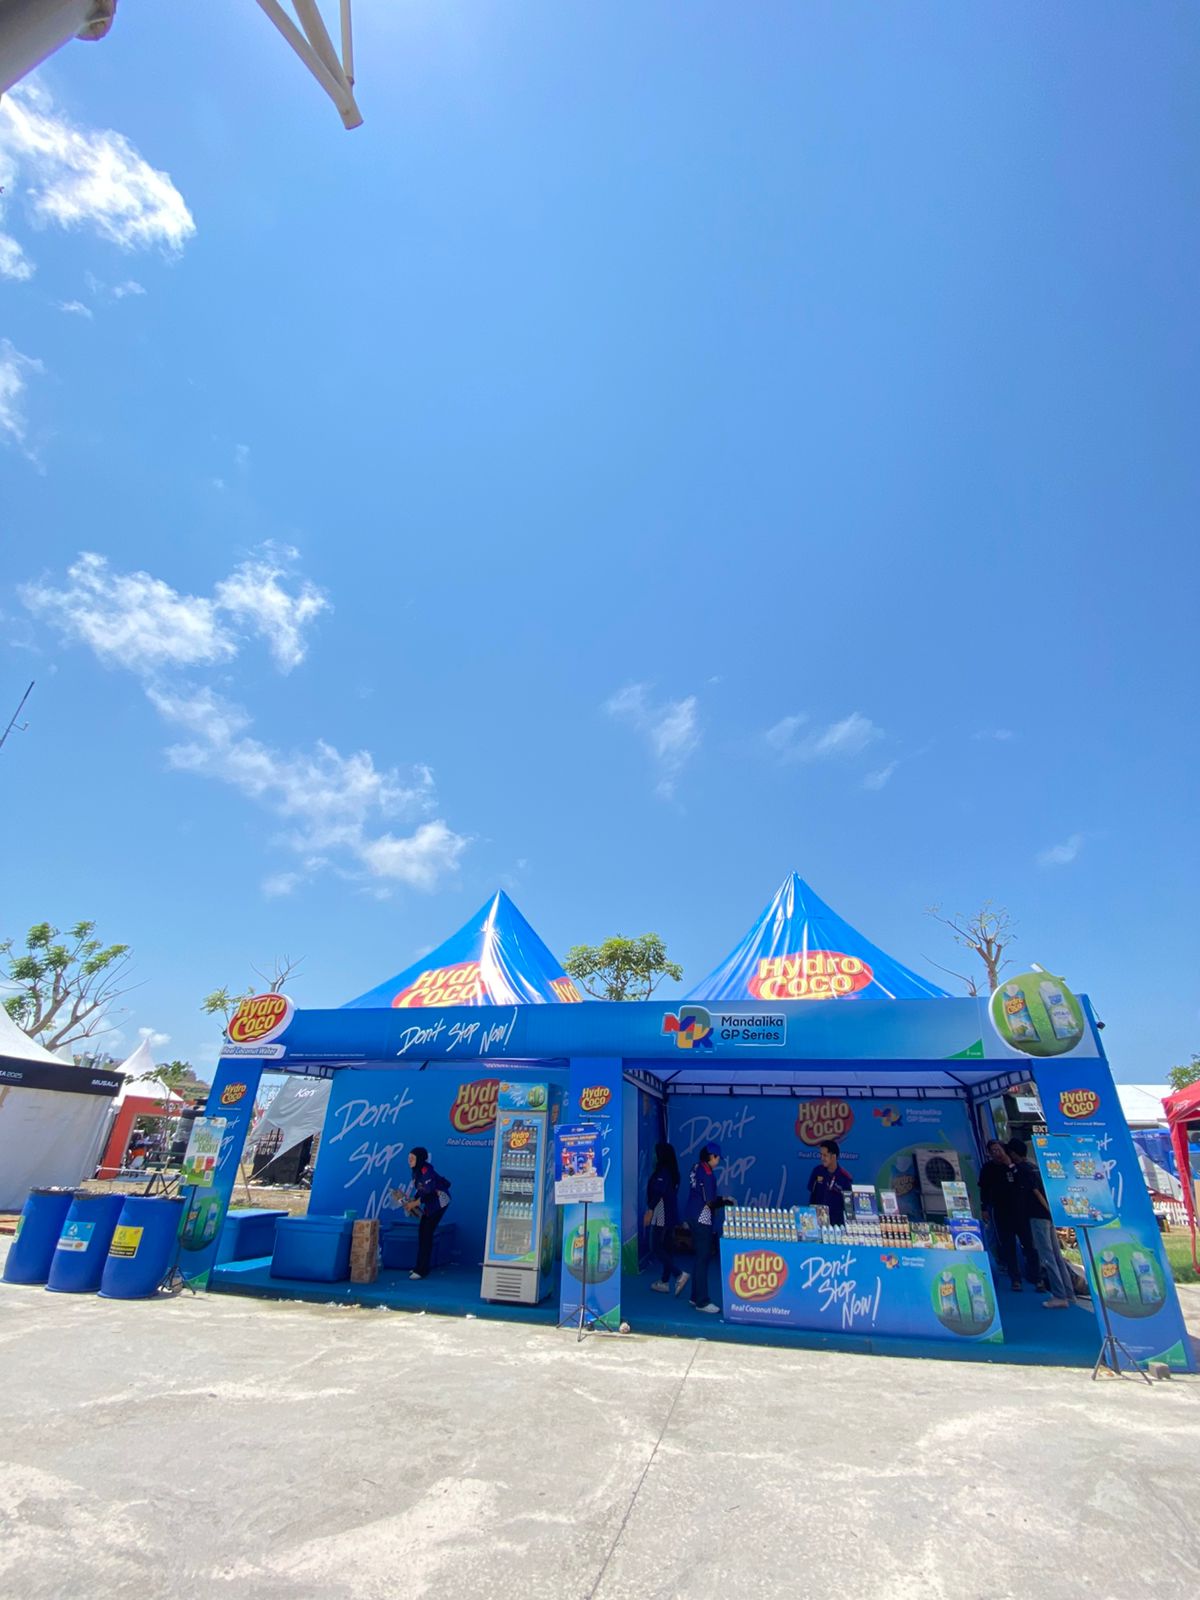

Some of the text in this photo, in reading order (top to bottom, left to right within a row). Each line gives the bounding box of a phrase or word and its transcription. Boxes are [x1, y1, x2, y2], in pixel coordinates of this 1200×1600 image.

[411, 962, 481, 991] Hydr
[760, 954, 863, 980] Hydro
[760, 973, 855, 1000] Coco
[237, 998, 286, 1018] Hydro
[721, 1015, 784, 1027] Mandalika
[232, 1015, 276, 1041] Coco
[397, 1006, 518, 1056] Don't Stop Now!
[721, 1030, 780, 1041] GP Series
[91, 1079, 119, 1088] MUSALA
[224, 1083, 247, 1097] Hydro
[458, 1081, 499, 1107] Hydr
[582, 1087, 610, 1099] Hydro
[222, 1093, 242, 1105] Coco
[582, 1097, 606, 1111] Coco
[1060, 1090, 1097, 1104] Hydro
[1062, 1101, 1095, 1119] Coco
[329, 1087, 414, 1145] Don't
[454, 1102, 499, 1132] Coco
[799, 1101, 849, 1122] Hydro
[461, 1138, 488, 1146] Coconut
[679, 1104, 756, 1158] Don't
[799, 1118, 845, 1146] Coco
[344, 1141, 405, 1189] Stop
[734, 1253, 784, 1274] Hydro
[800, 1249, 857, 1289] Don't
[734, 1272, 778, 1298] Coco
[818, 1278, 857, 1312] Stop
[731, 1303, 791, 1315] Real Coconut Water
[842, 1276, 881, 1330] Now!
